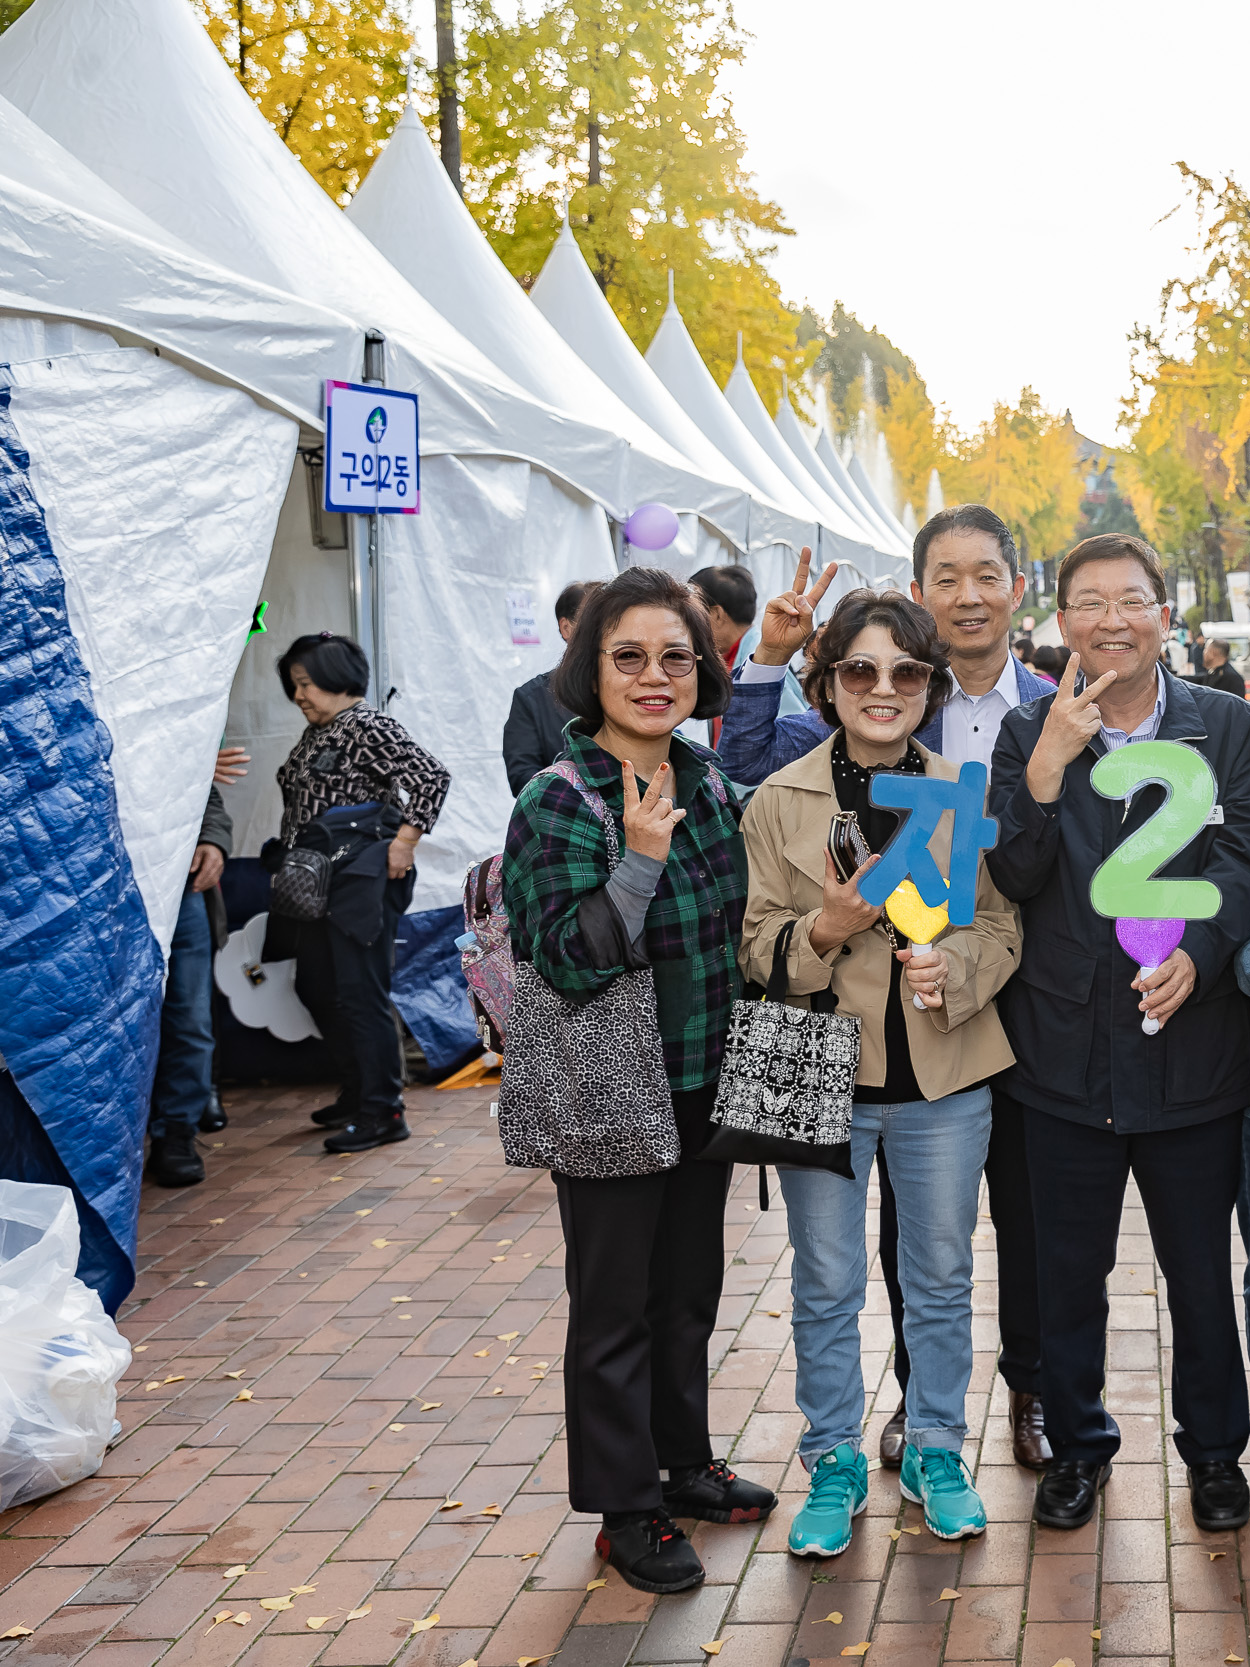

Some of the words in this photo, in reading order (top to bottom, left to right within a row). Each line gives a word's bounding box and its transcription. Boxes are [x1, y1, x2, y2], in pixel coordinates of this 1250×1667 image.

[340, 451, 410, 497] 구의2동
[858, 761, 998, 926] 자
[1090, 740, 1222, 918] 2
